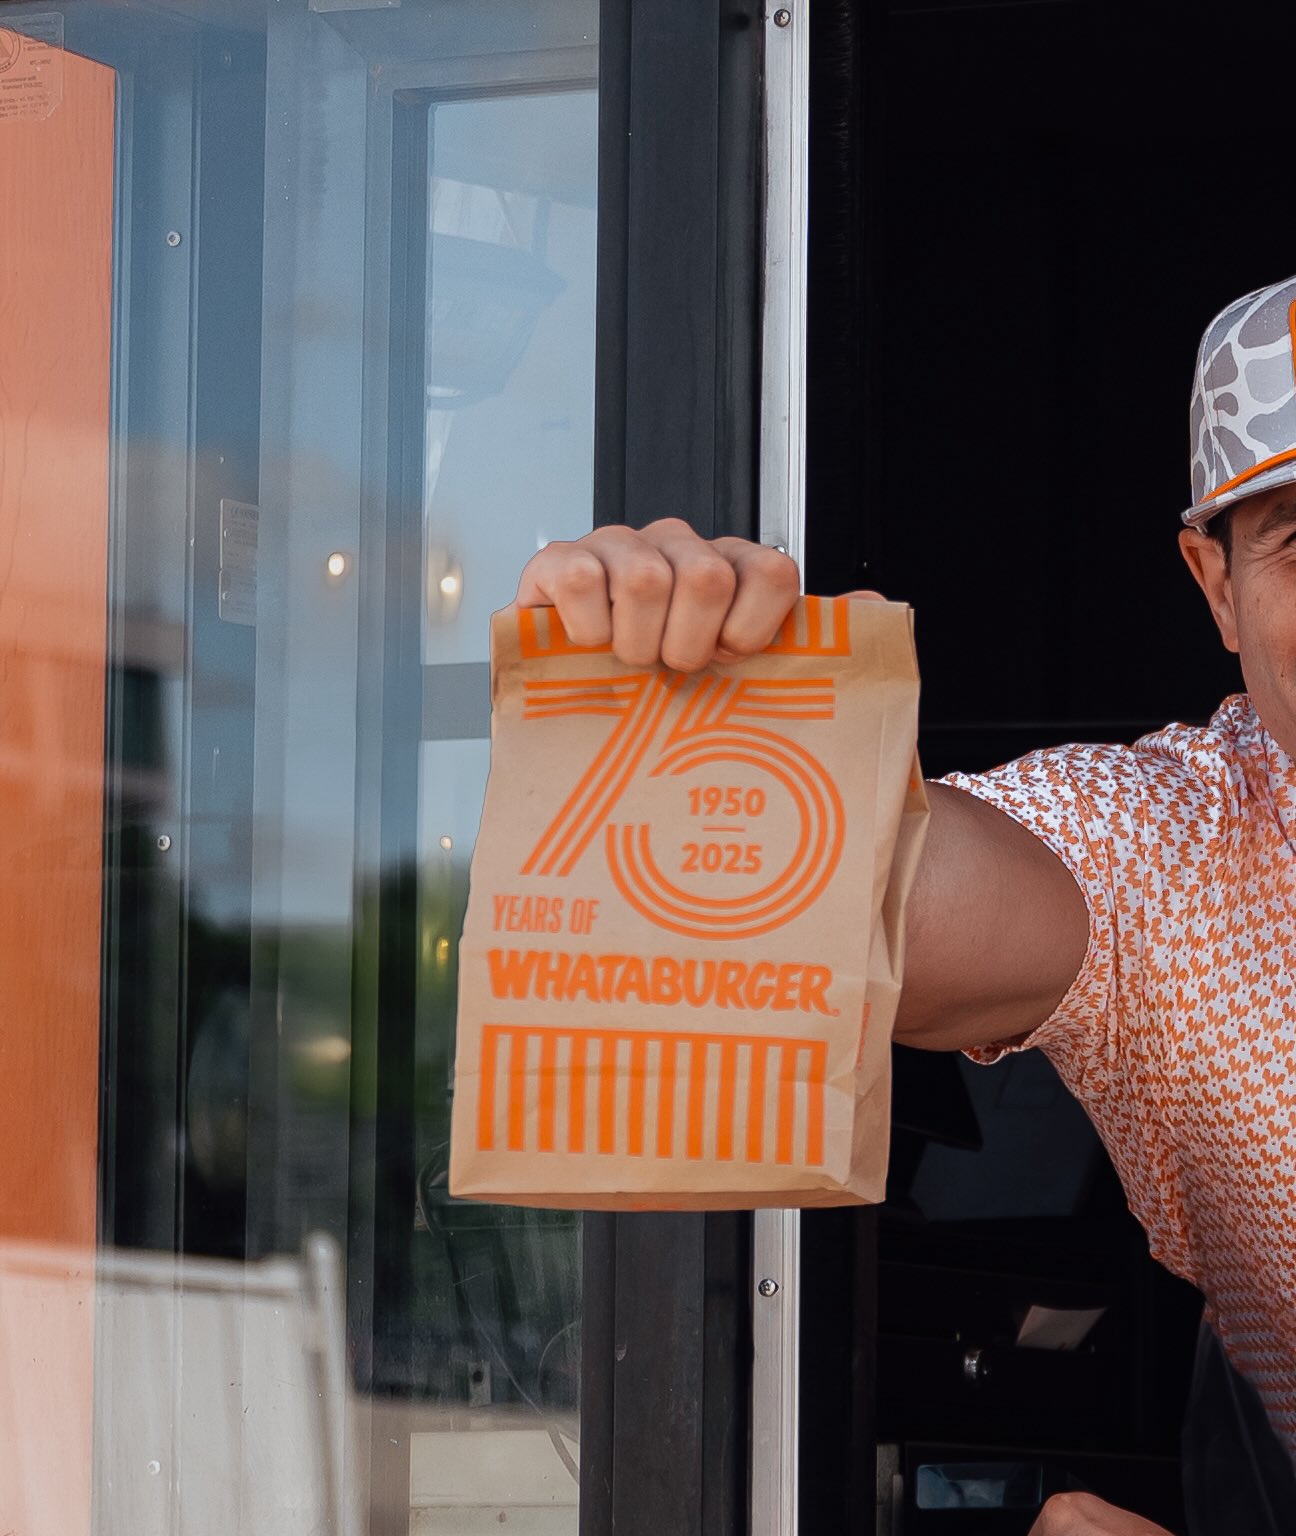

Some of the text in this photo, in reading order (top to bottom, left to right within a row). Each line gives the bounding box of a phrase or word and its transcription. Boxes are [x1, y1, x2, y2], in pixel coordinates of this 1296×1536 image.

[519, 671, 847, 941] 75
[687, 786, 766, 817] 1950
[681, 842, 762, 874] 2025
[493, 895, 600, 935] YEARS OF
